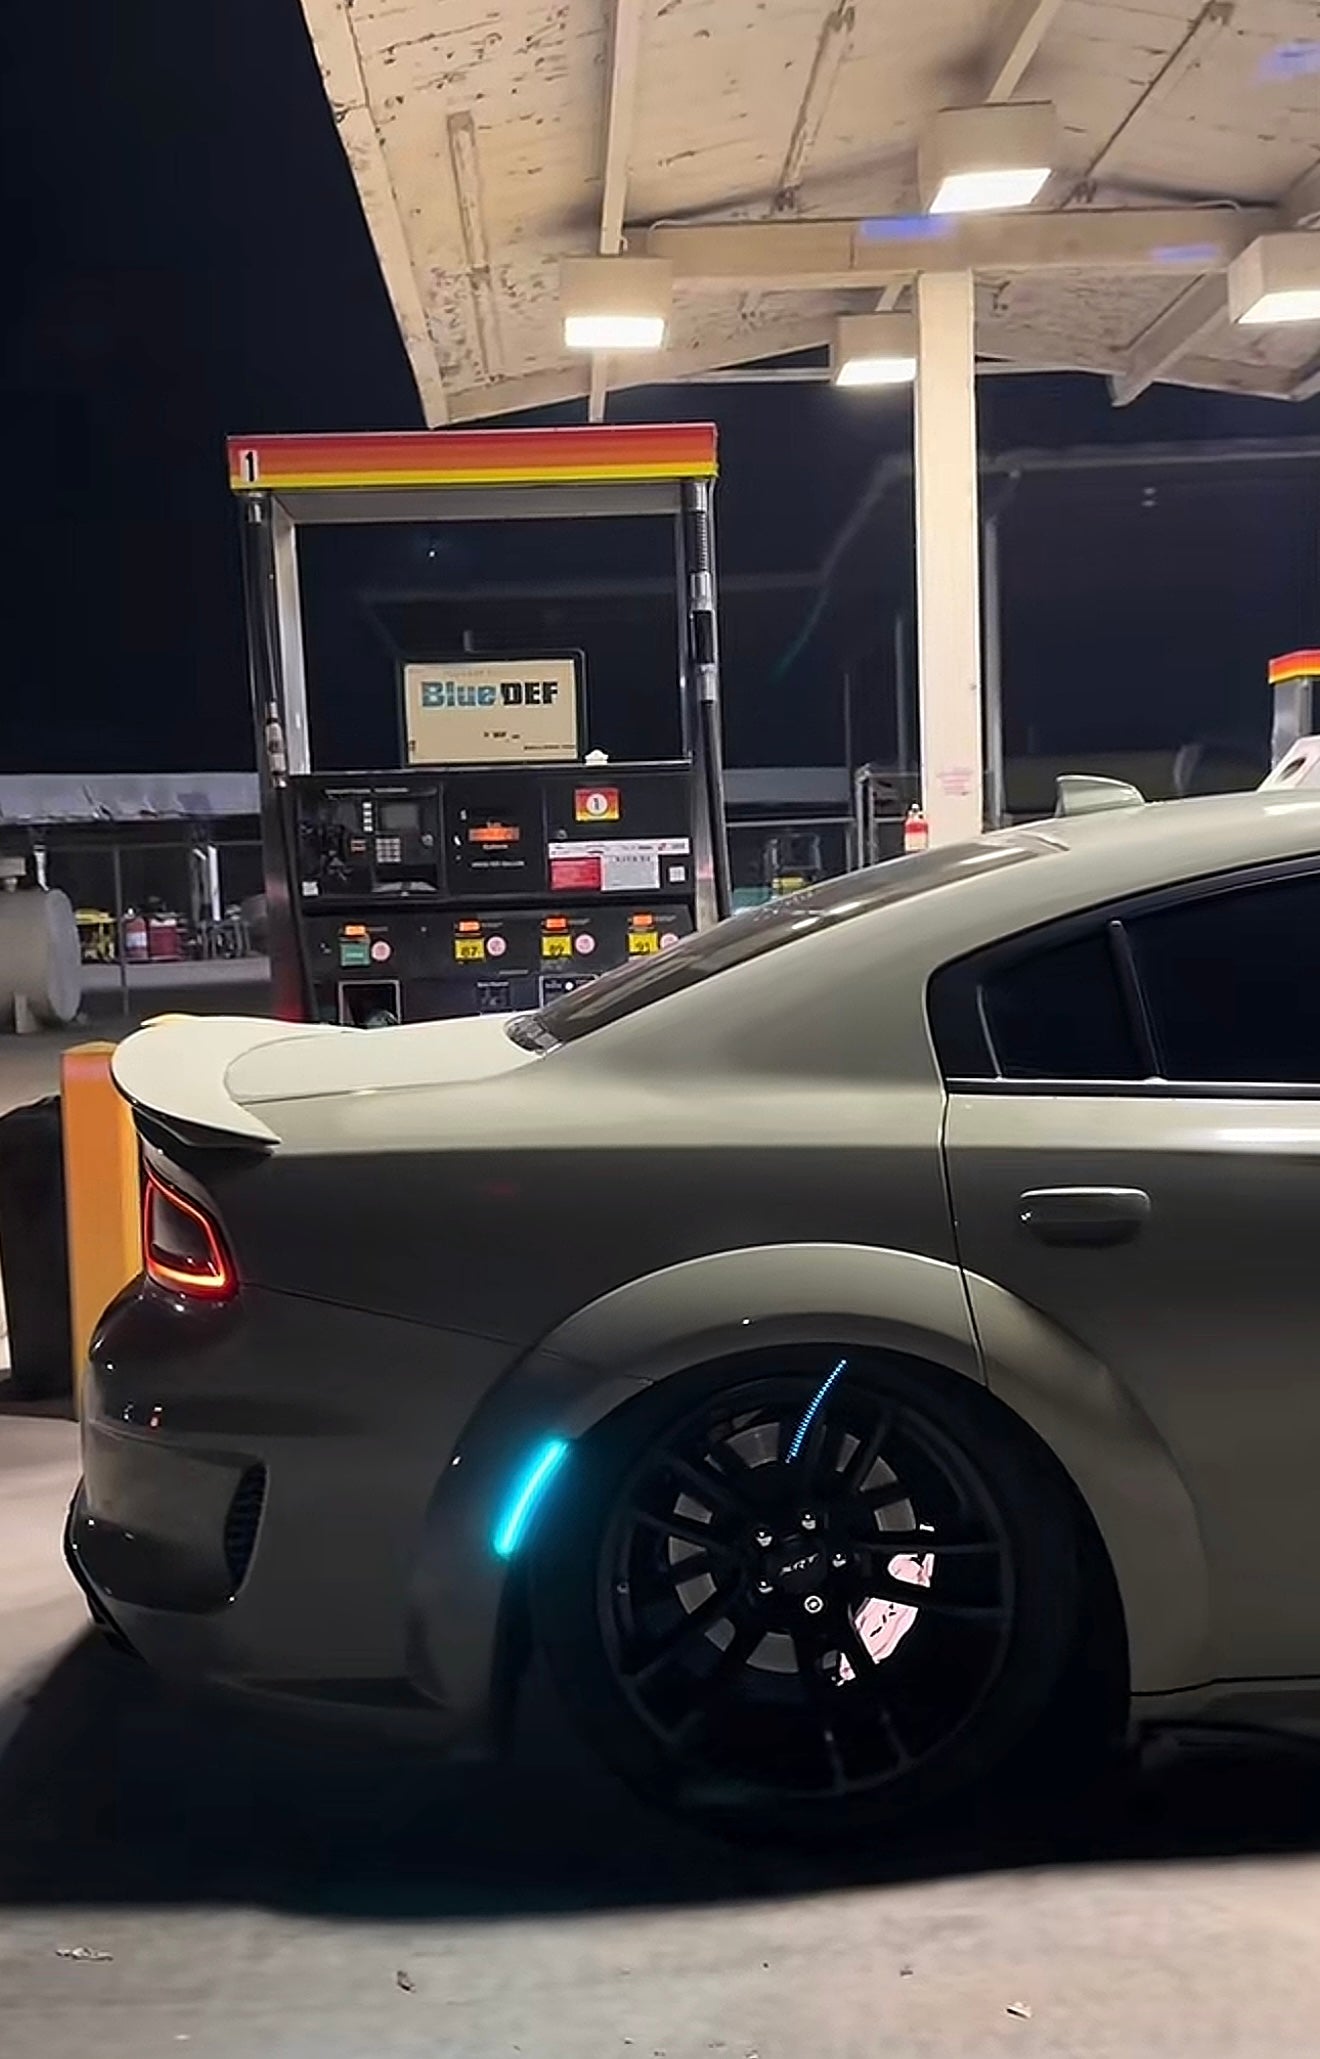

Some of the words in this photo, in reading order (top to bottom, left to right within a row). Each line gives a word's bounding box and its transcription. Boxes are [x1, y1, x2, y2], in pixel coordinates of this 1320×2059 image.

[245, 451, 255, 482] 1
[421, 681, 497, 707] Blue
[500, 681, 558, 705] DEF
